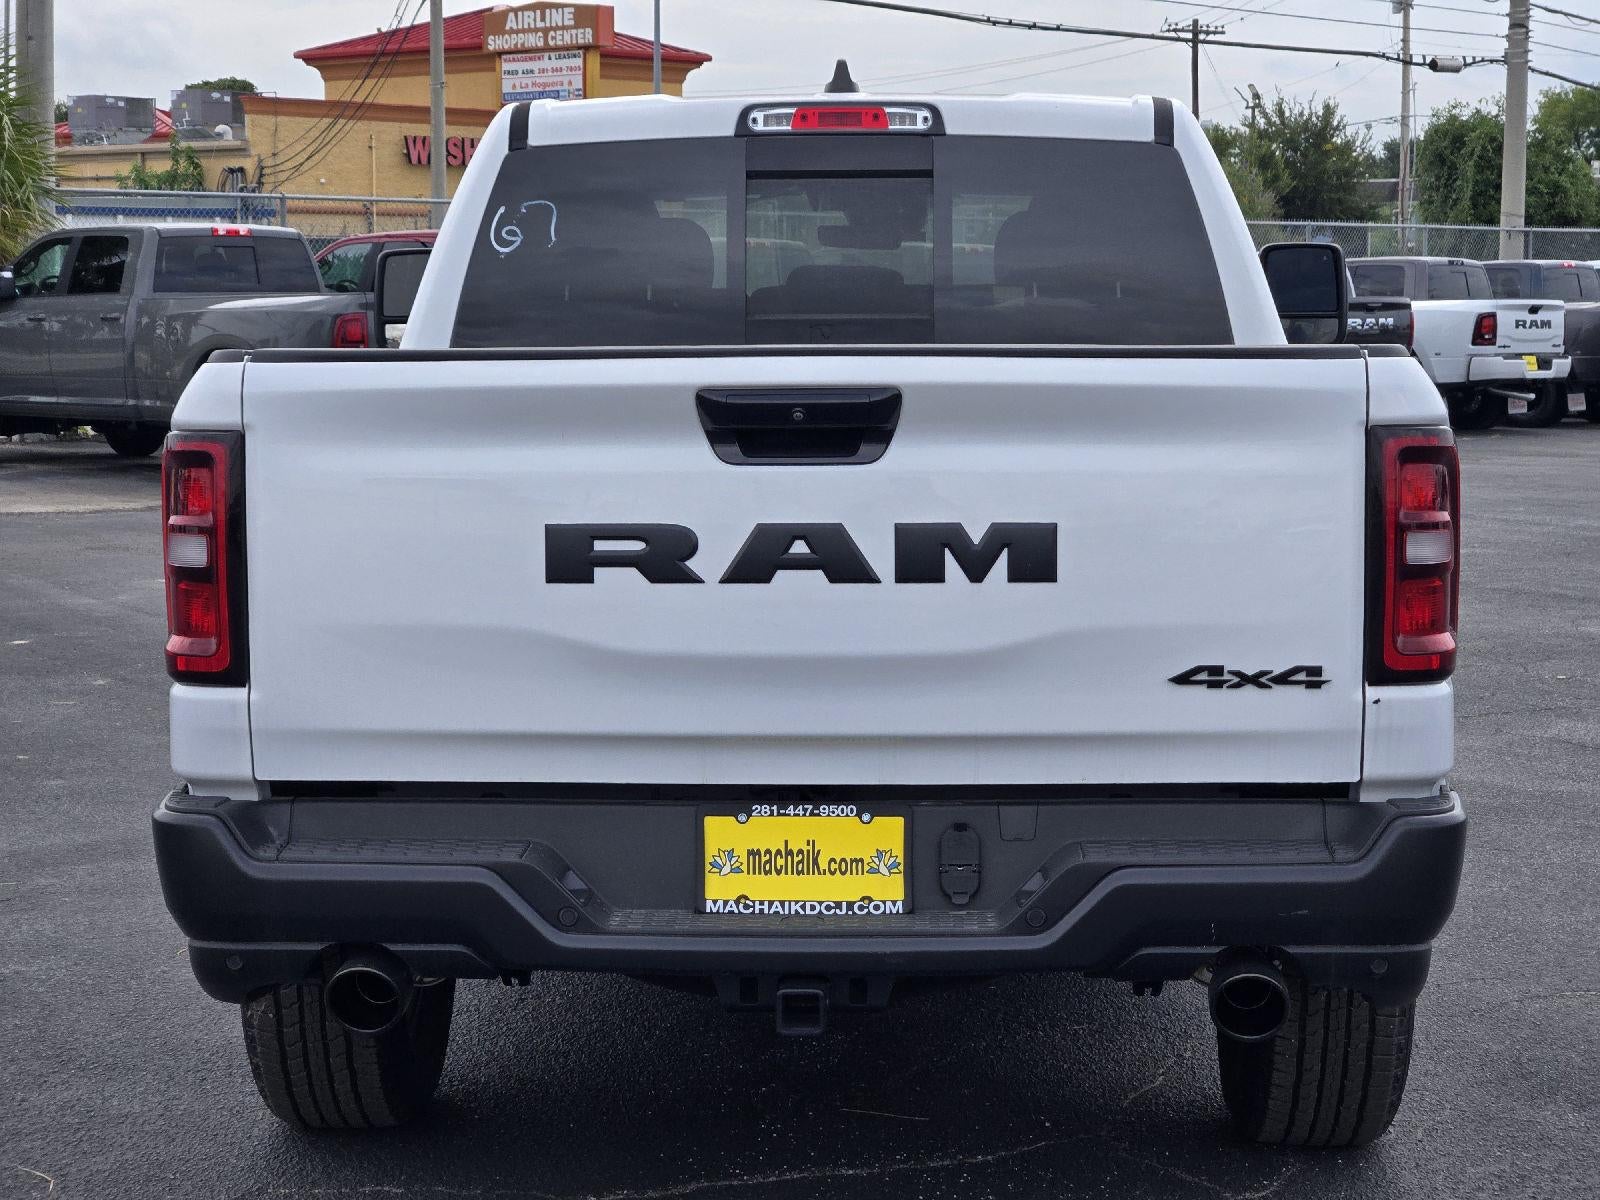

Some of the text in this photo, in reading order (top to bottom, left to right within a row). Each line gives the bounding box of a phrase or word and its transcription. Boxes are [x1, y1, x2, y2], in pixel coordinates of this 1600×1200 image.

[505, 7, 575, 30] AIRLINE
[487, 27, 593, 50] SHOPPING CENTER
[554, 51, 581, 60] LEASING
[519, 79, 564, 90] La Hoguera
[404, 134, 483, 168] WSH
[1347, 317, 1394, 330] RAM
[1514, 319, 1552, 330] RAM
[544, 522, 1058, 584] RAM
[1167, 664, 1332, 689] 4x4
[751, 804, 858, 817] 281-447-9500
[746, 839, 865, 876] machaik.com
[705, 899, 904, 915] MACHAIKDCJ.COM
